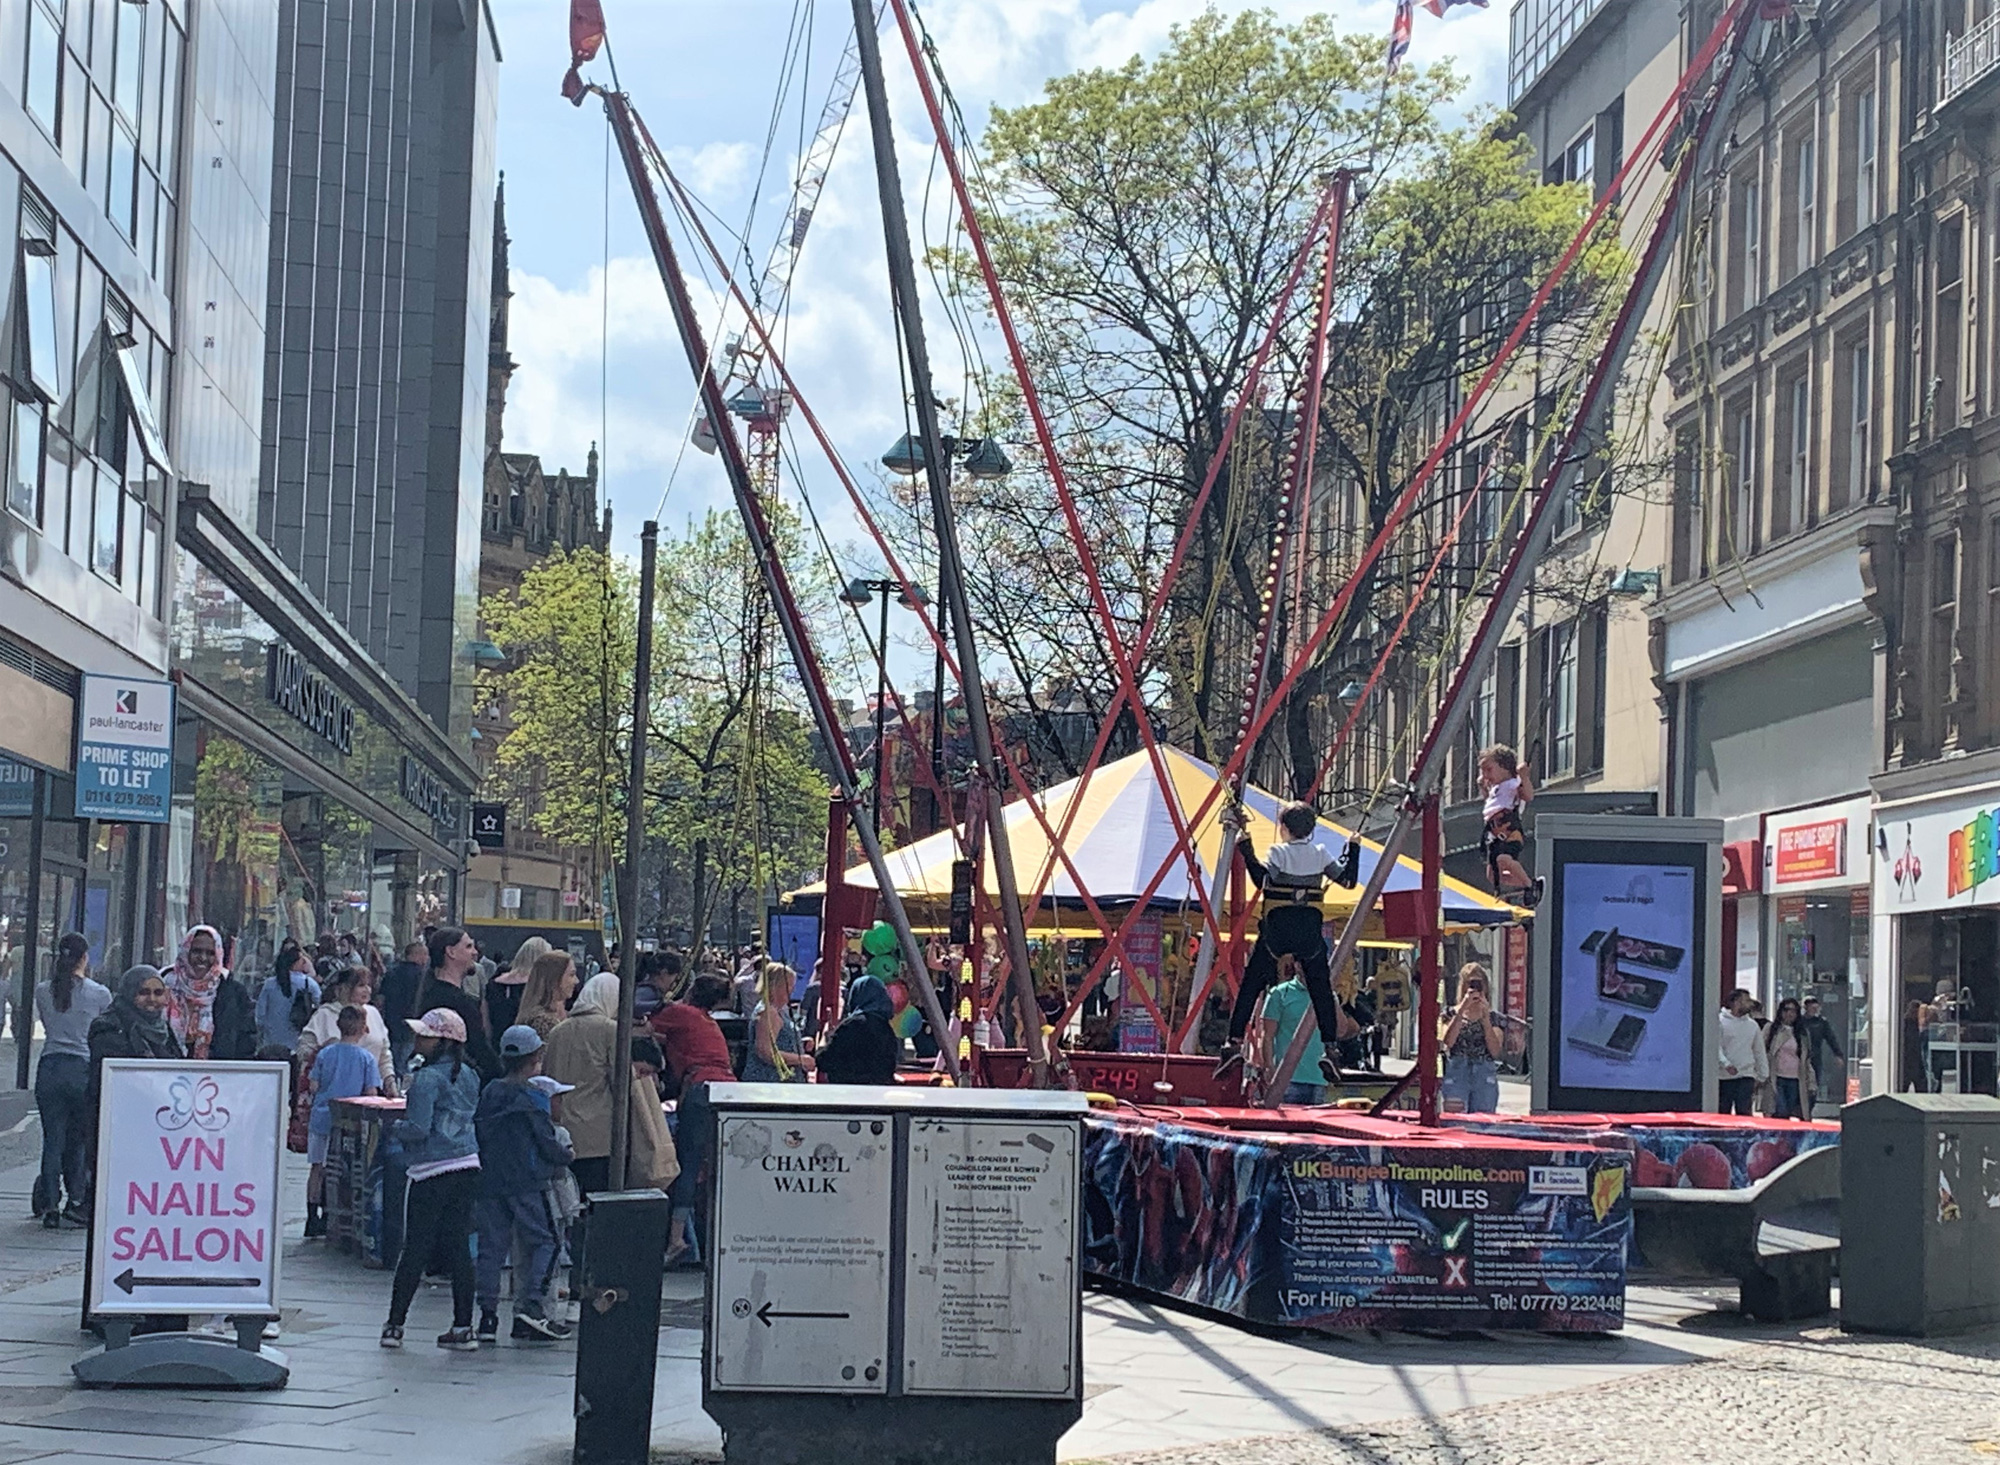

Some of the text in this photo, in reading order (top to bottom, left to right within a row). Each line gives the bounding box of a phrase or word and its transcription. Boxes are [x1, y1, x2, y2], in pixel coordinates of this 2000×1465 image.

[89, 716, 164, 732] paul-lancaster
[82, 746, 169, 769] PRIME SHOP
[98, 767, 153, 788] TO LET
[85, 789, 111, 803] 0114
[114, 791, 134, 805] 279
[1780, 823, 1835, 851] THE PHONE SHOP
[1092, 1069, 1139, 1091] 249
[160, 1136, 225, 1172] VN
[944, 1164, 992, 1172] COUNCILLOR
[1293, 1160, 1527, 1185] UKBungeeTrampoline.com
[774, 1176, 838, 1194] WALK
[127, 1181, 256, 1218] NAILS
[1421, 1188, 1489, 1210] RULES
[111, 1226, 264, 1263] SALON
[1293, 1258, 1316, 1269] Jump
[1327, 1260, 1344, 1272] your
[1345, 1260, 1362, 1268] own
[1293, 1273, 1334, 1285] Thankyou
[1334, 1274, 1349, 1283] and
[1351, 1275, 1372, 1285] enjoy
[1373, 1275, 1385, 1284] the
[1387, 1275, 1425, 1284] ULTIMATE
[1288, 1289, 1317, 1307] For
[1320, 1290, 1356, 1308] Hire
[1490, 1293, 1517, 1310] Tel:
[1520, 1294, 1567, 1311] 07779
